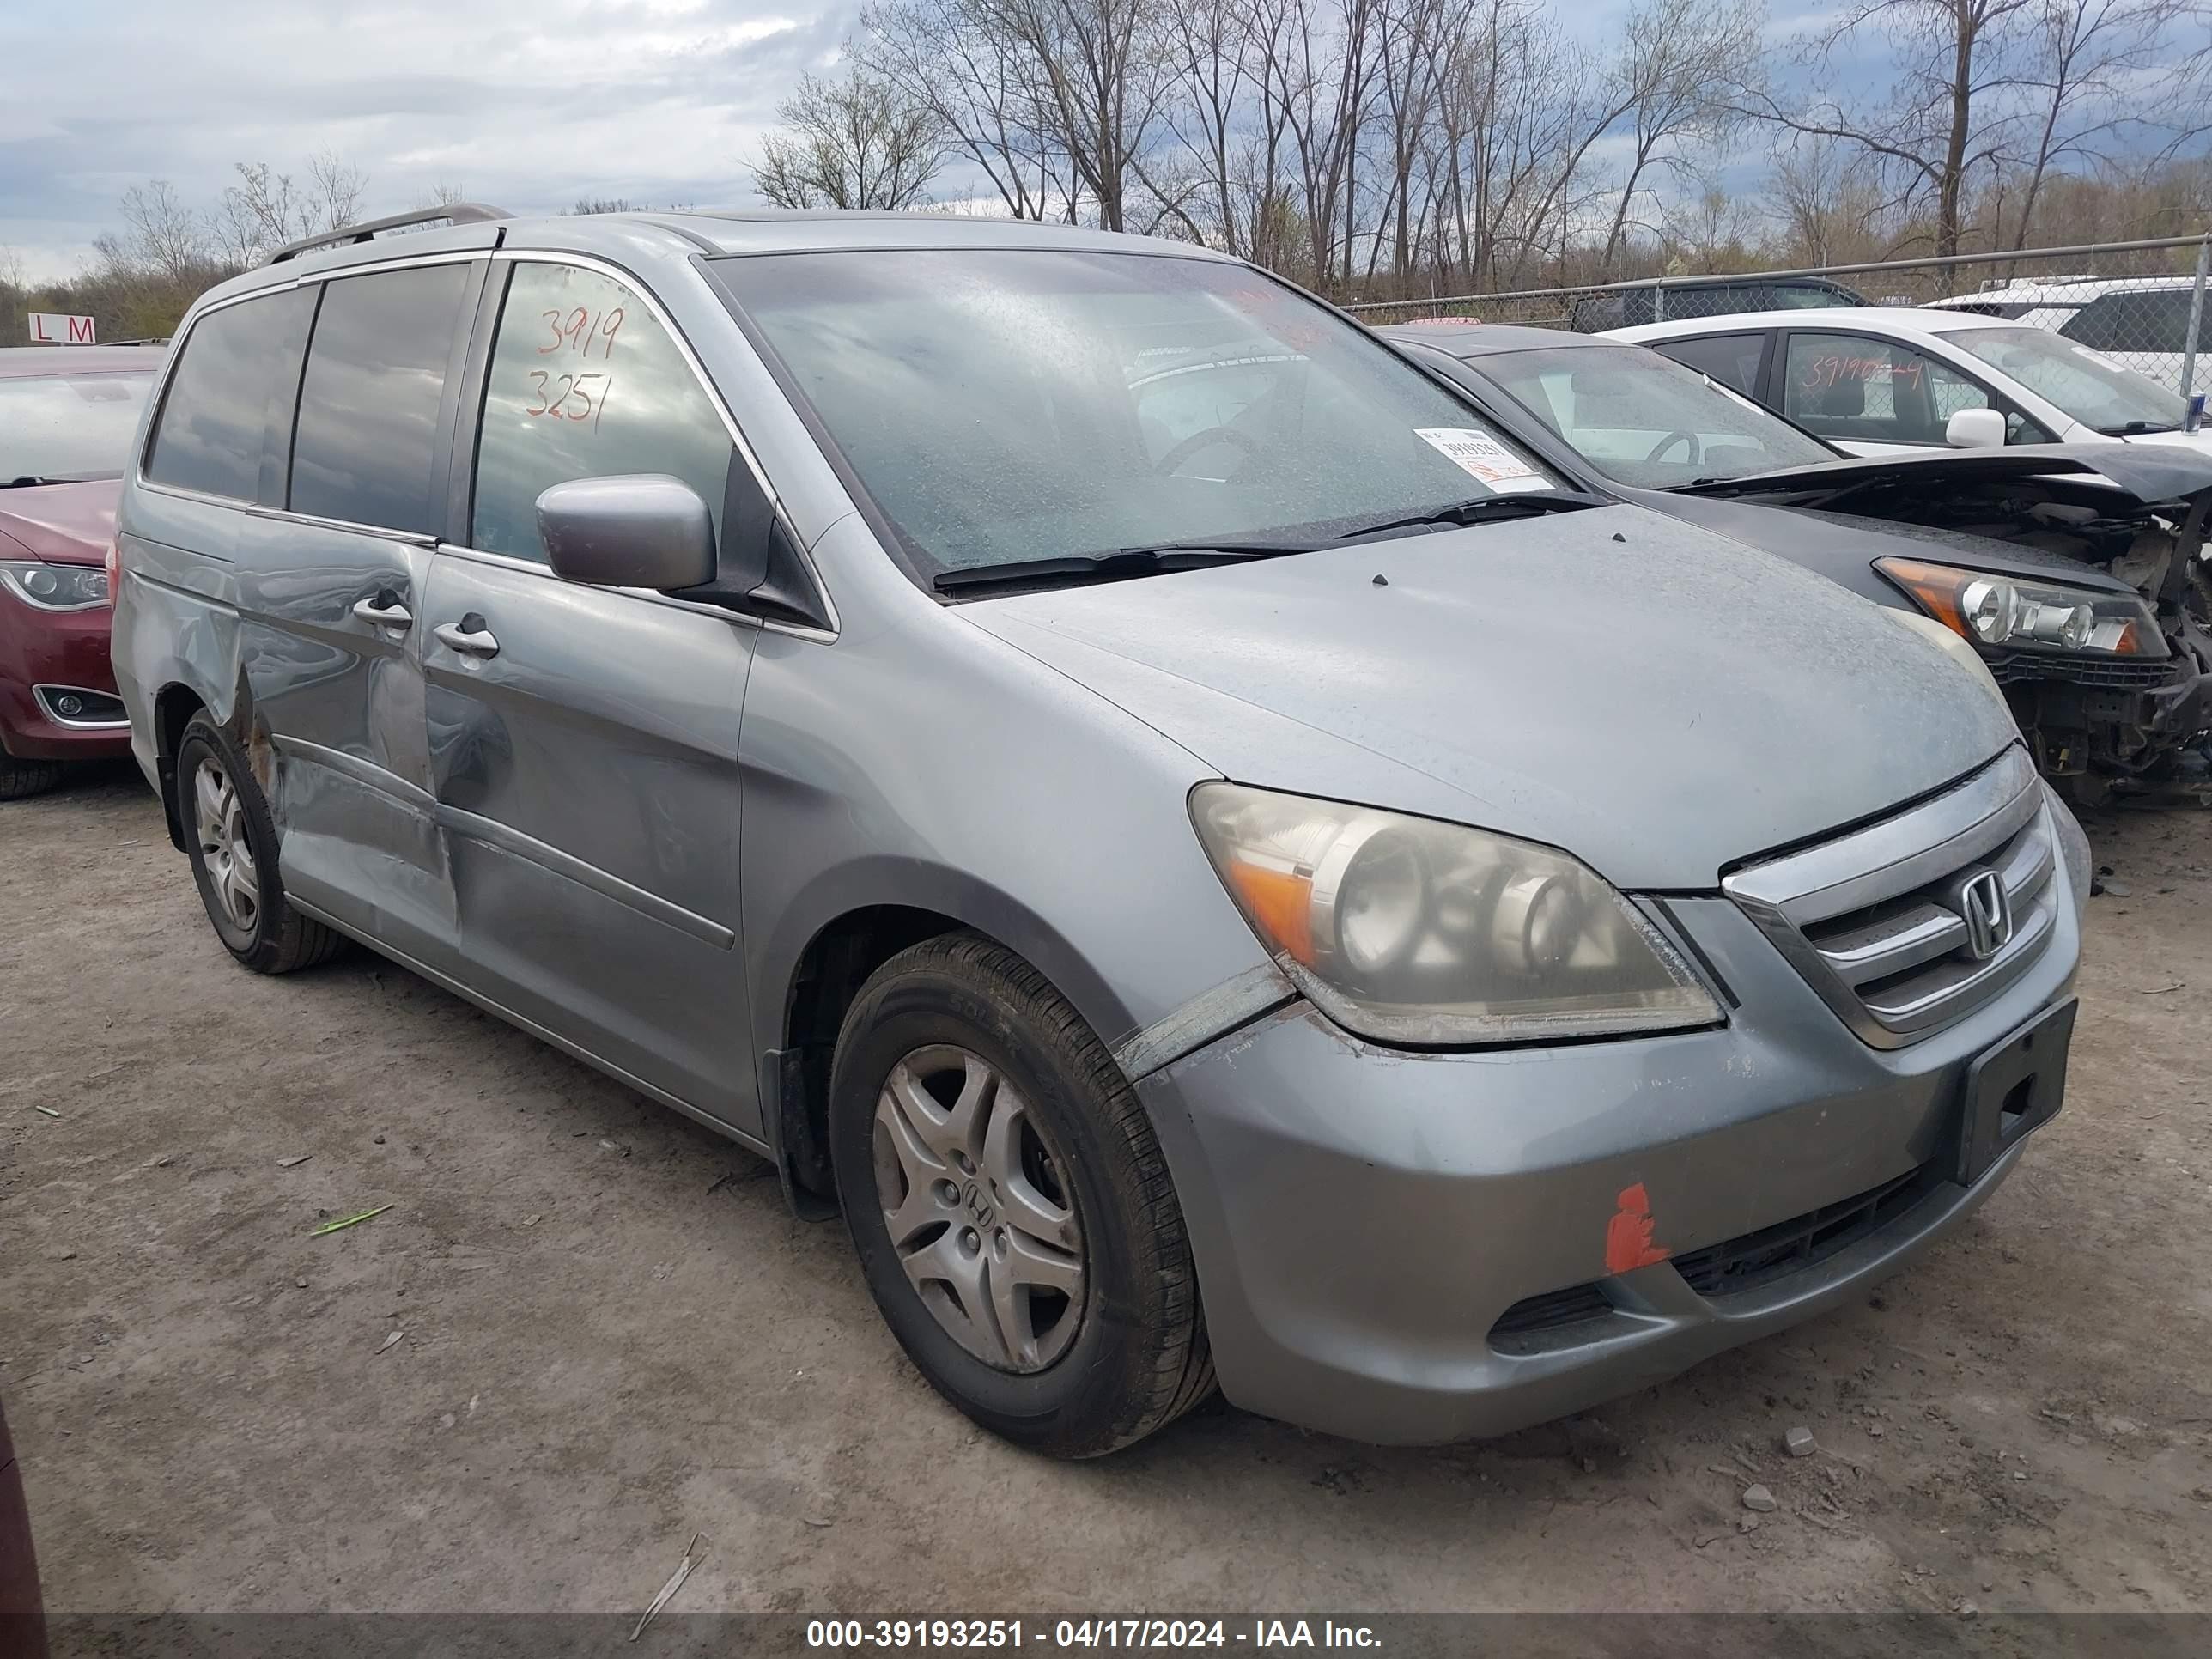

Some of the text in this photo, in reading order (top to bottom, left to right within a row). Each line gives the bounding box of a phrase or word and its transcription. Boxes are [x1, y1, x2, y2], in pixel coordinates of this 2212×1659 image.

[36, 314, 94, 343] L M
[538, 307, 623, 359] 3919
[526, 370, 612, 435] 3251
[1442, 441, 1506, 457] 39193251
